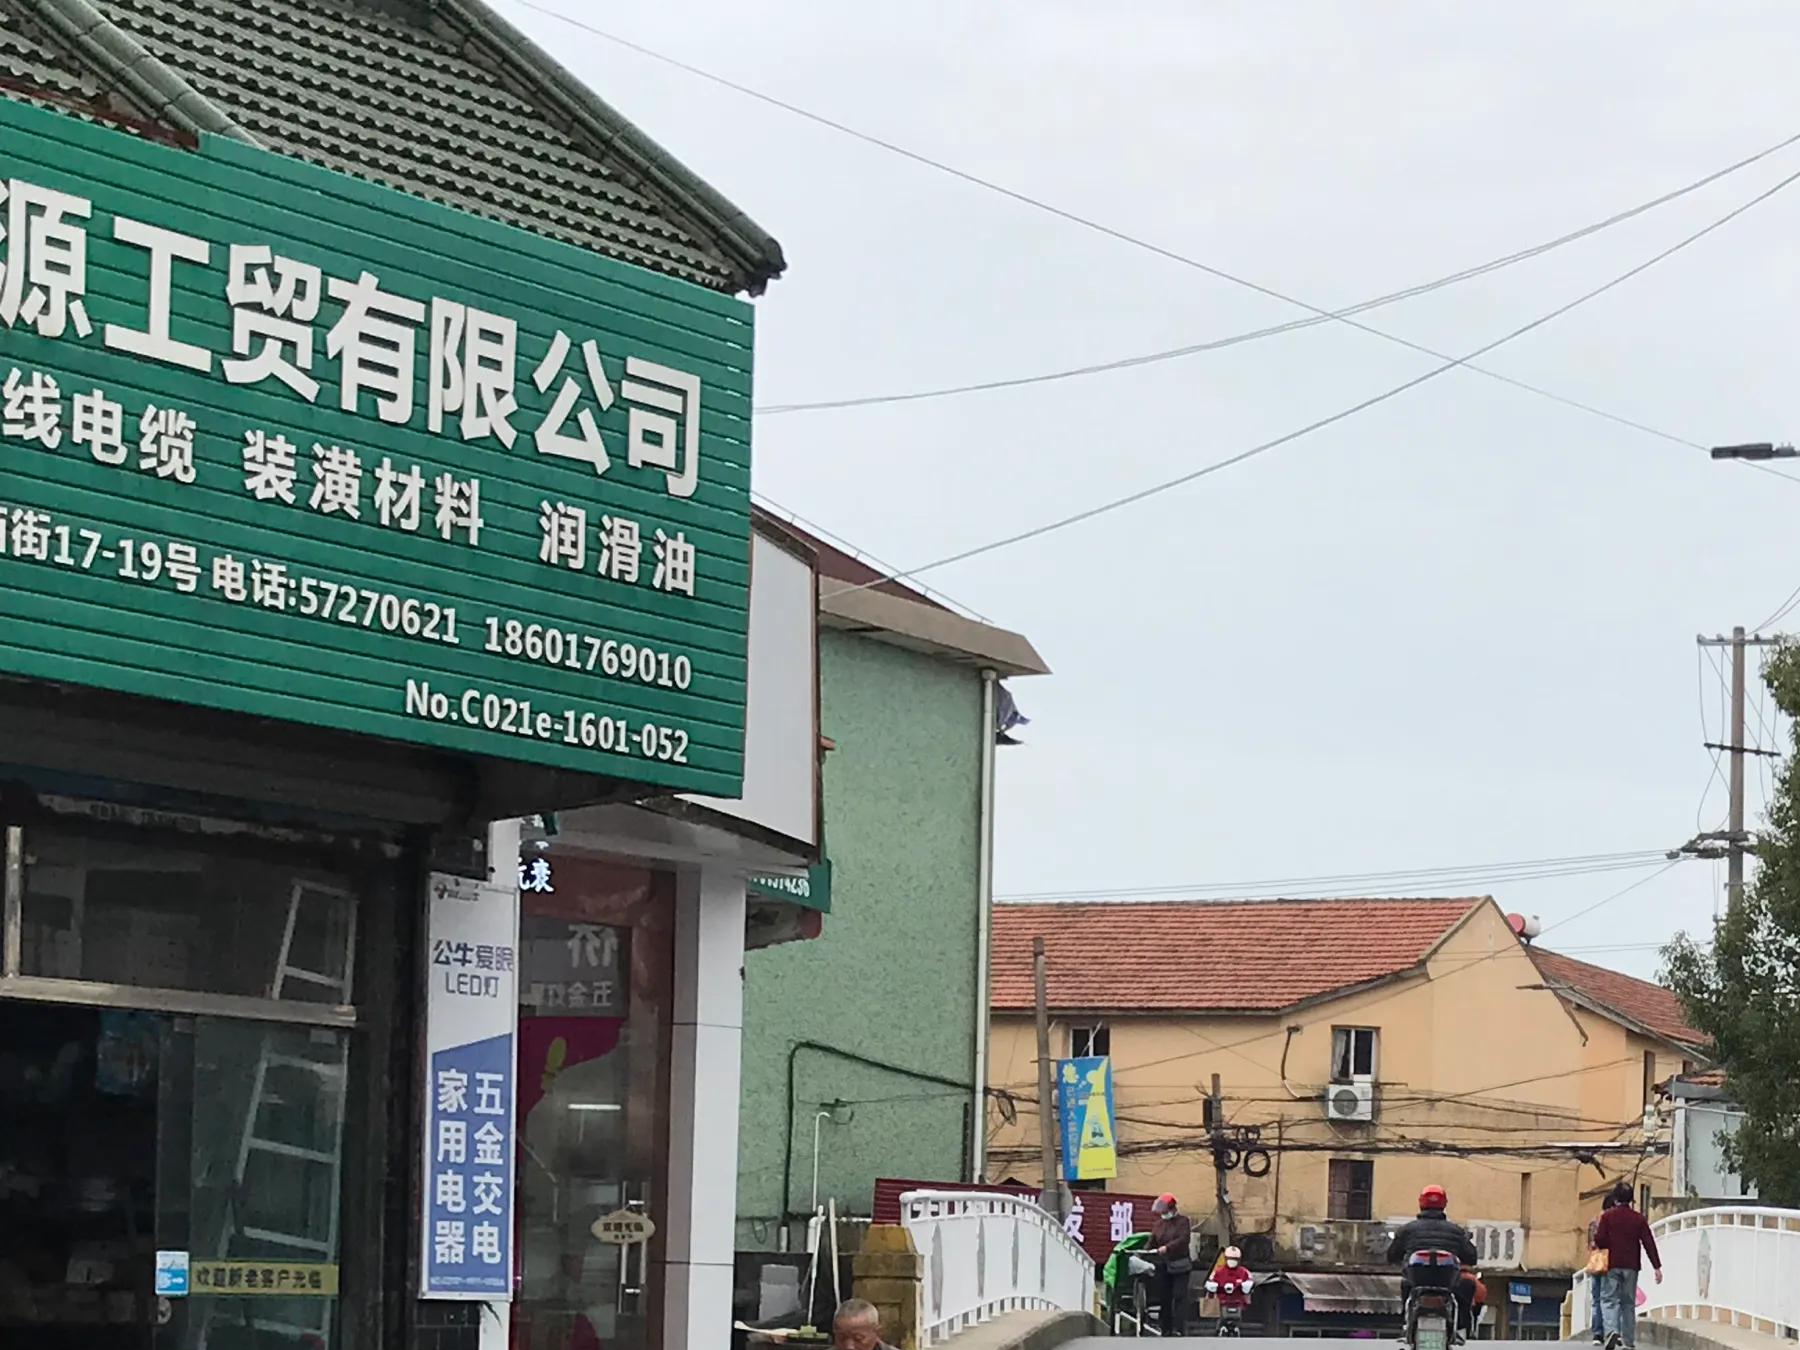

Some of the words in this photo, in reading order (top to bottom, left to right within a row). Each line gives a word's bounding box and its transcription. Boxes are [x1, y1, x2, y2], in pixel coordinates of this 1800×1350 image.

[0, 177, 701, 499] 源工贸有限公司
[2, 367, 197, 484] 线电缆
[243, 430, 484, 546] 装潢材料
[538, 500, 697, 598] 润滑油
[0, 506, 201, 592] 街17-19号
[211, 554, 460, 644] 电话:57270621
[484, 616, 692, 690] 18601769010
[405, 679, 689, 764] No.C021e-1601-052
[433, 939, 514, 971] 公牛爱眼
[445, 971, 499, 998] LED灯
[434, 1068, 469, 1265] 家用电器
[471, 1071, 505, 1265] 五金交电
